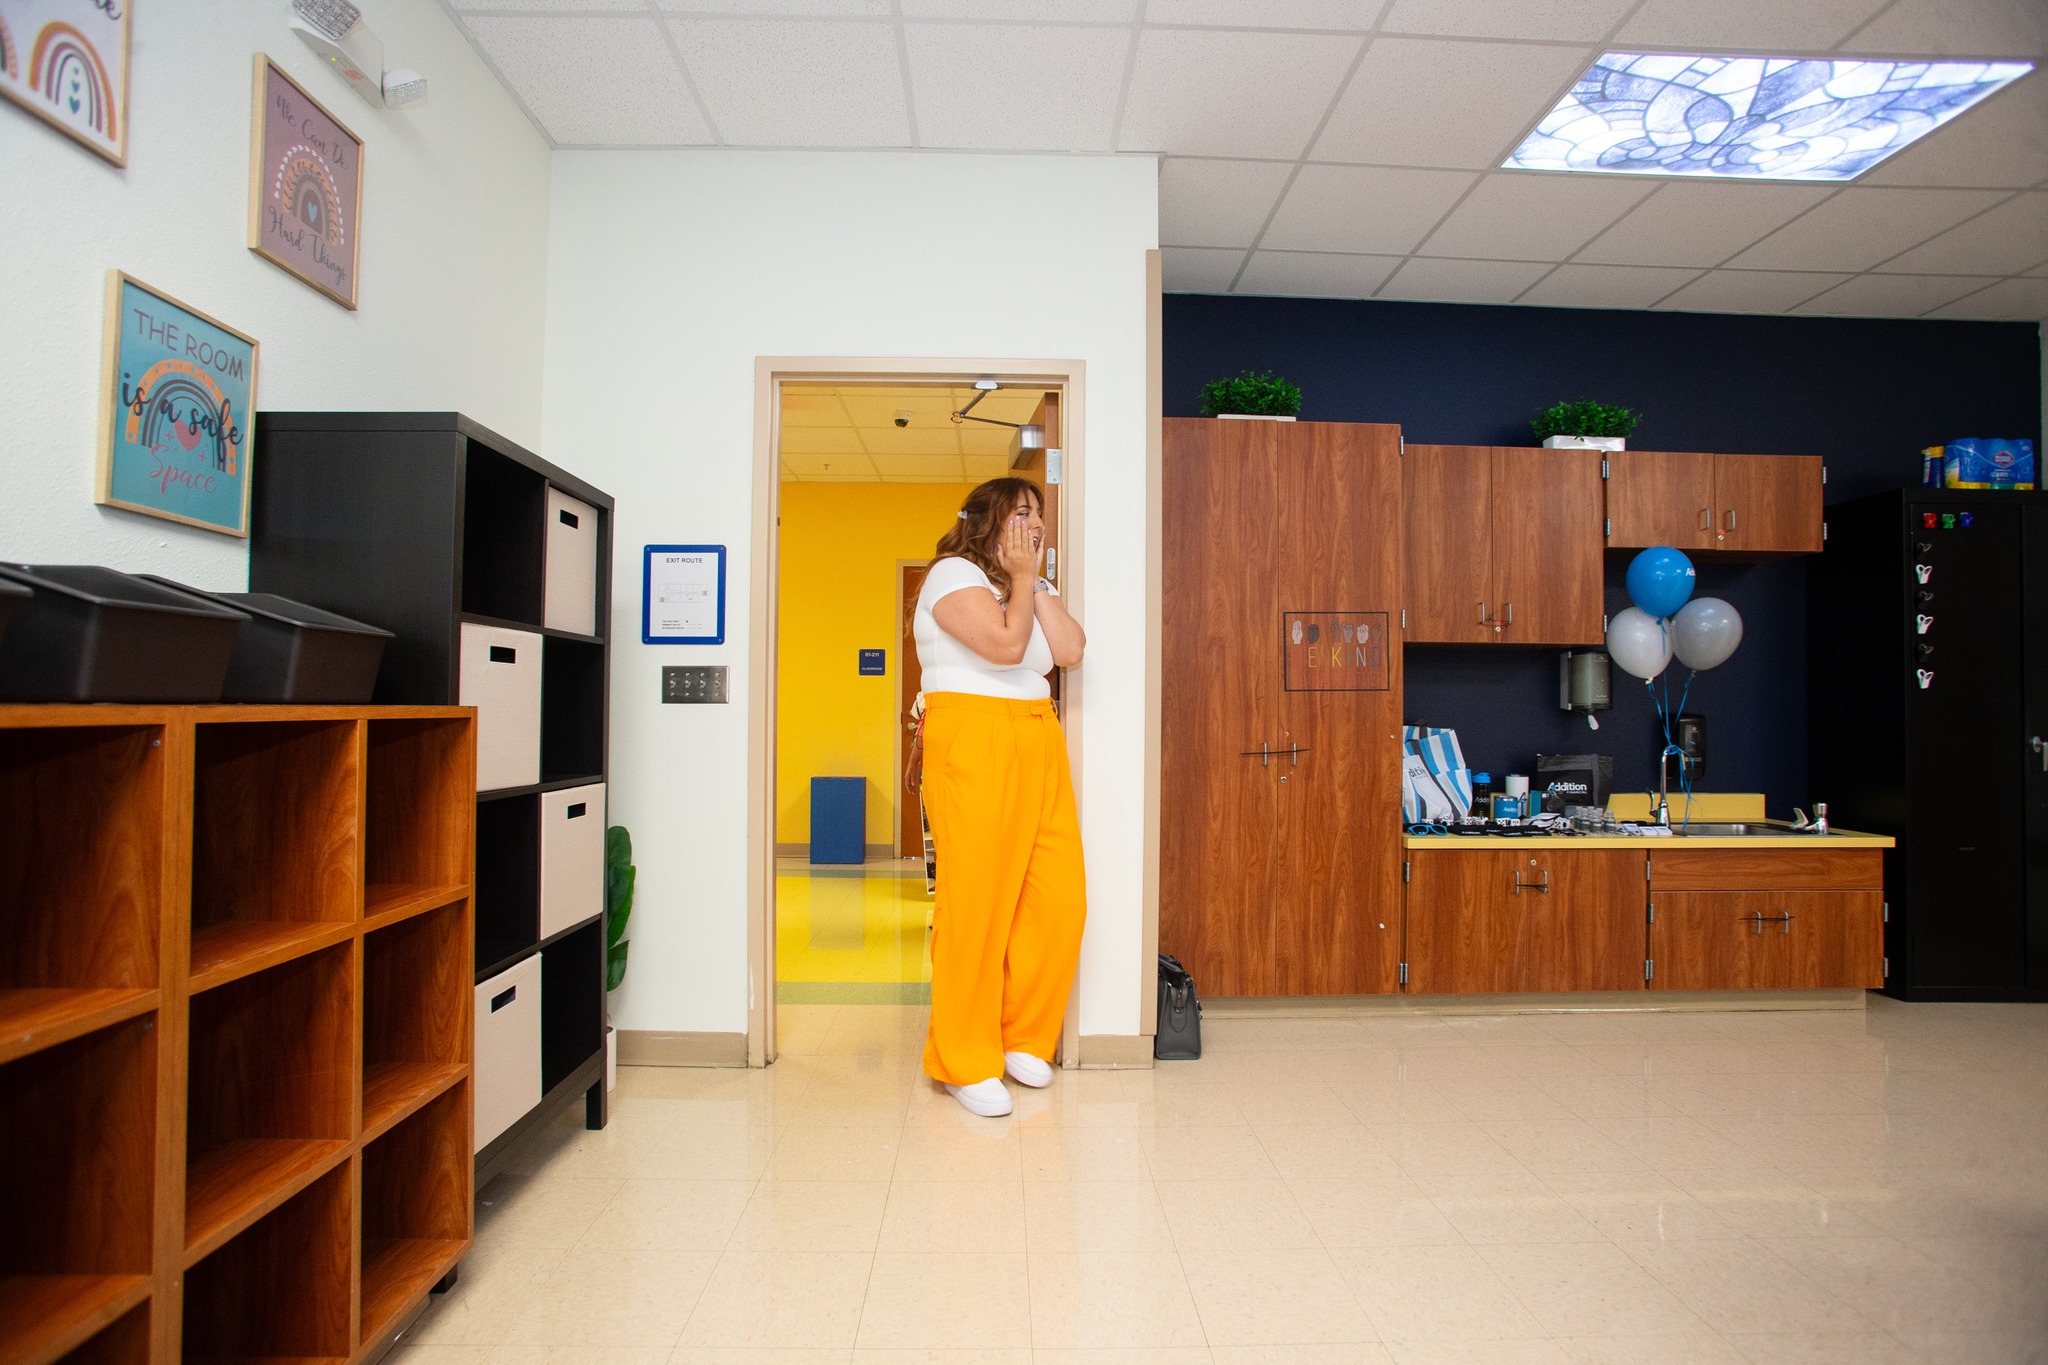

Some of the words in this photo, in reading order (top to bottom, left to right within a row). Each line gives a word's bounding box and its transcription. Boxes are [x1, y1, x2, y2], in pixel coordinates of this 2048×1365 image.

[302, 119, 328, 155] Can
[269, 206, 304, 251] Hard
[308, 234, 346, 285] Things
[134, 309, 178, 351] THE
[185, 333, 243, 381] ROOM
[122, 372, 150, 417] is
[160, 399, 182, 424] a
[189, 398, 244, 463] safe
[149, 444, 217, 494] Space
[1331, 646, 1382, 668] KIND
[1547, 782, 1588, 791] Addition
